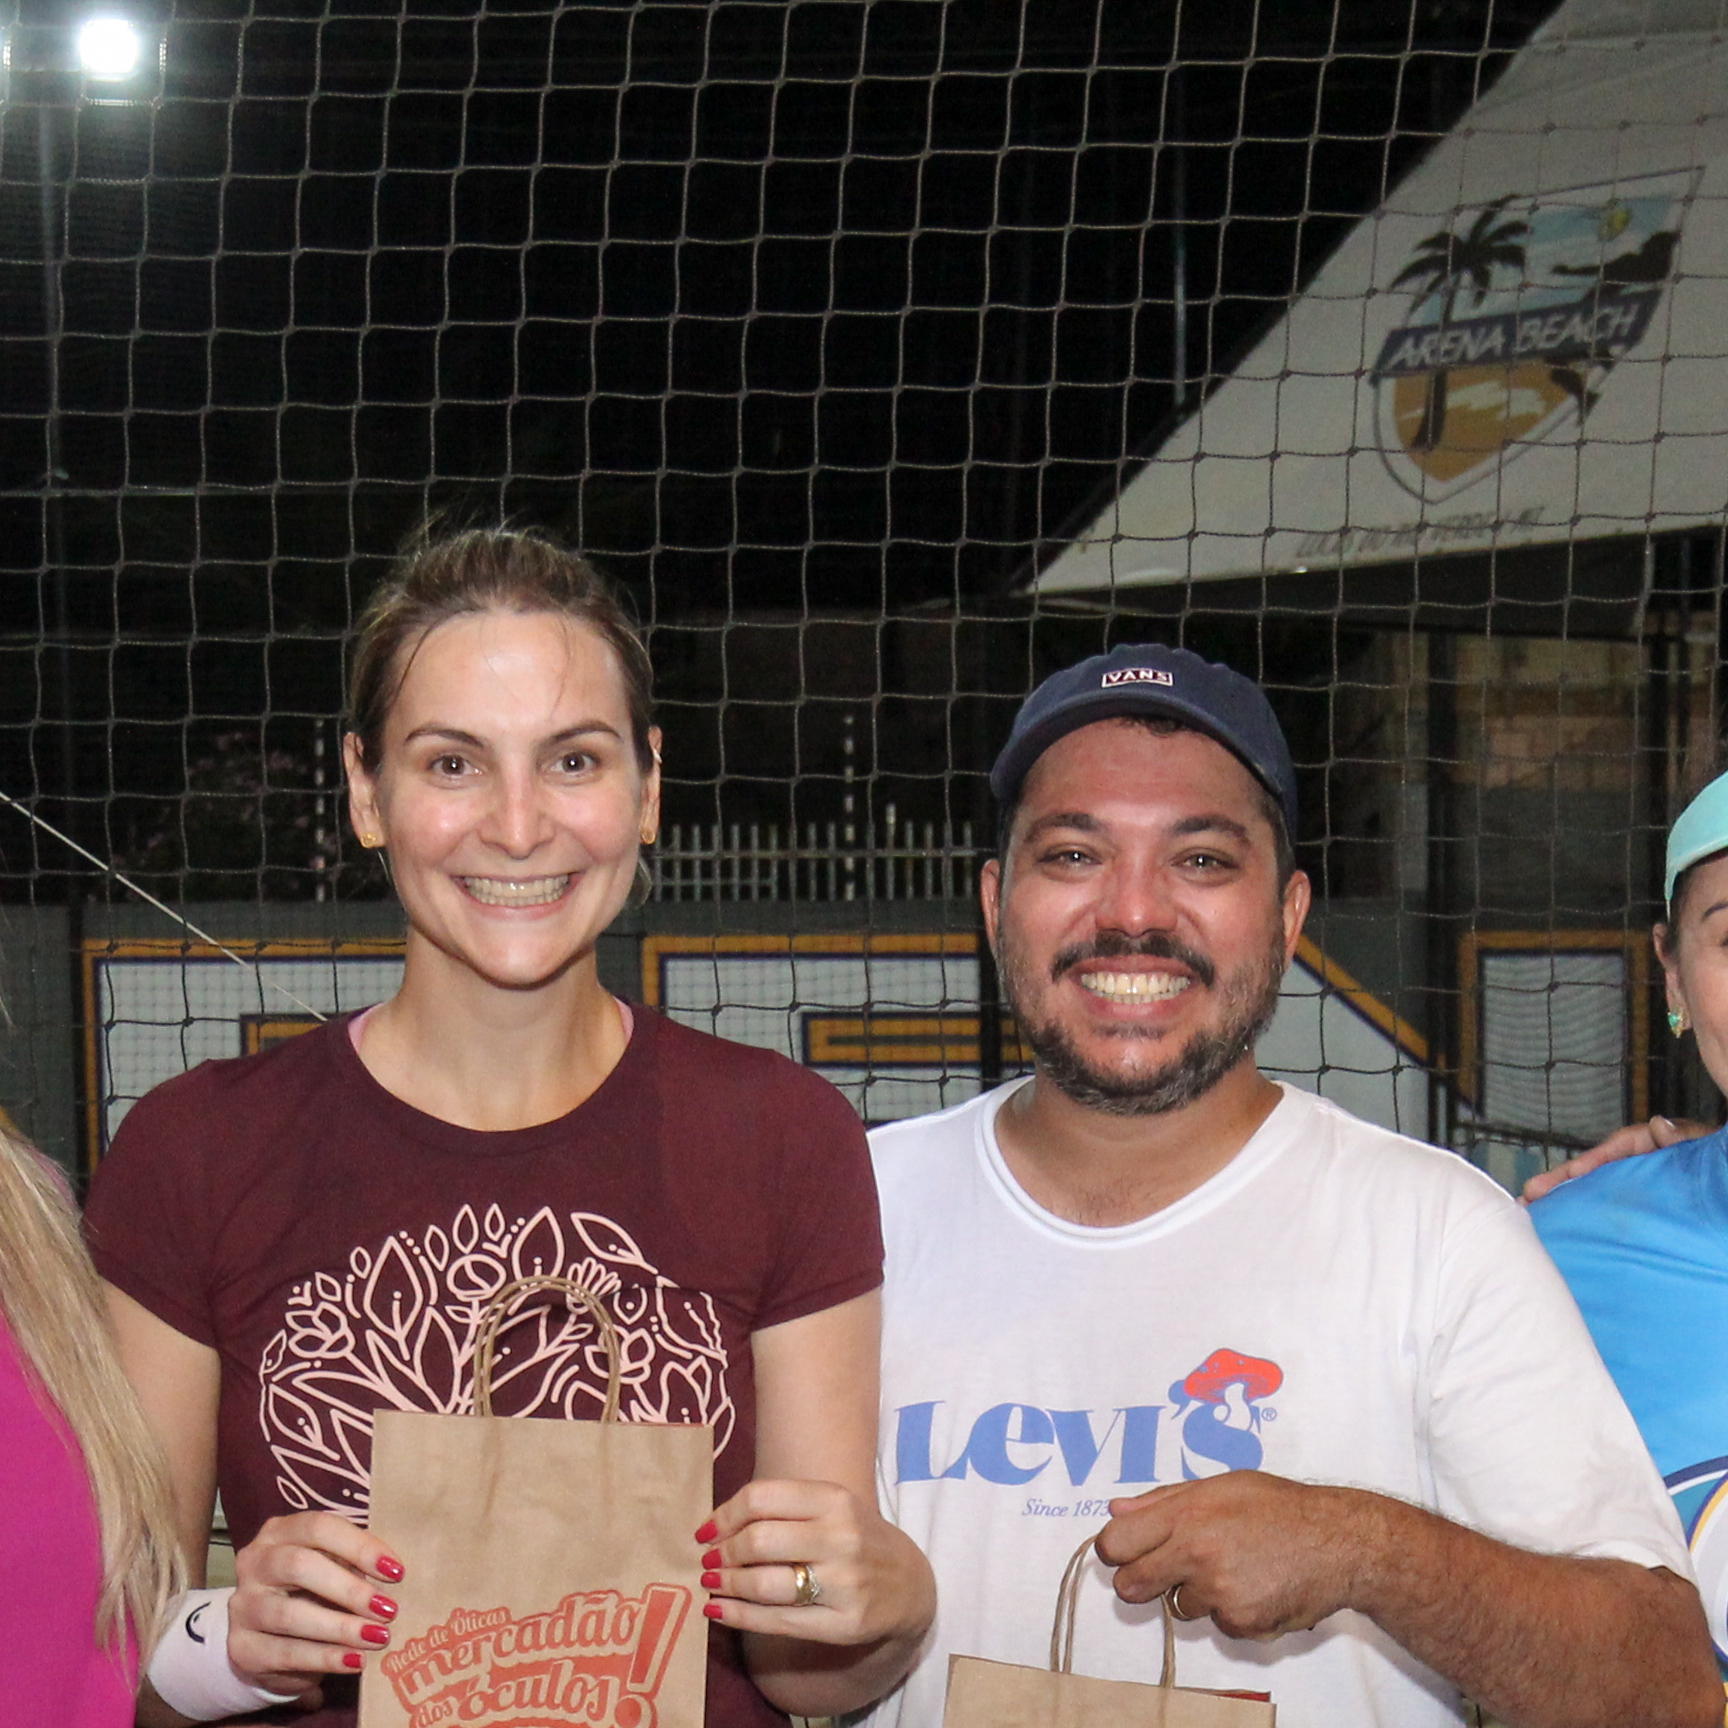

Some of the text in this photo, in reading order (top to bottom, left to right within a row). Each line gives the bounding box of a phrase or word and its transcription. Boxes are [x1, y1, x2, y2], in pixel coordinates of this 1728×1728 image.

[1385, 303, 1640, 372] ARENA BEACH
[1108, 669, 1168, 683] VANS
[1022, 1498, 1069, 1518] Since
[387, 1640, 427, 1674] Rede
[429, 1625, 449, 1647] de
